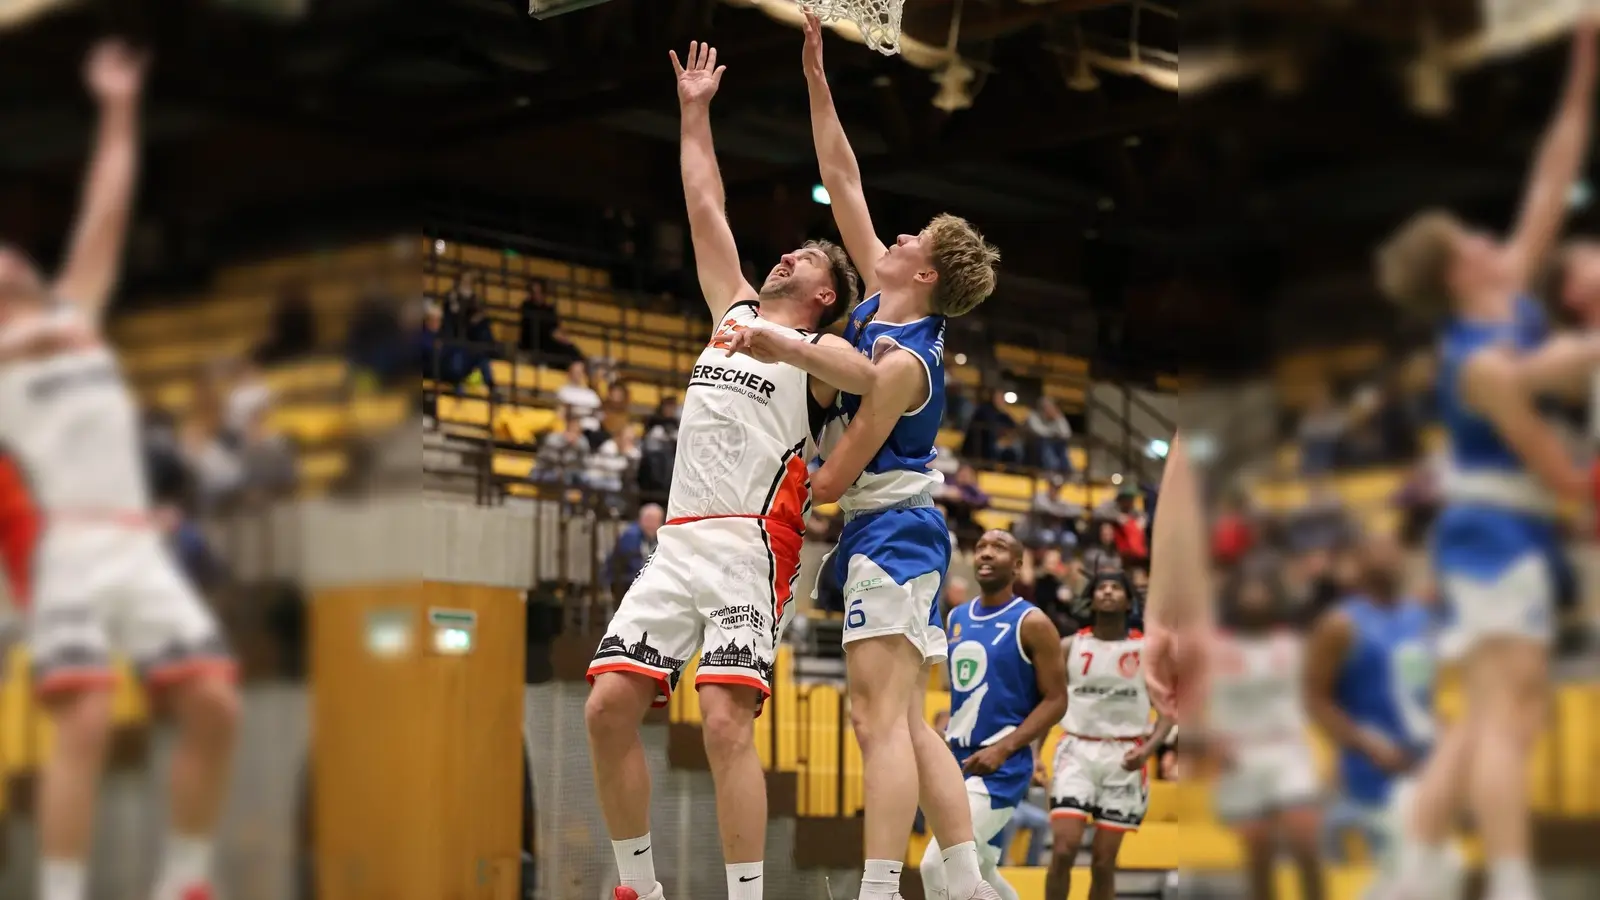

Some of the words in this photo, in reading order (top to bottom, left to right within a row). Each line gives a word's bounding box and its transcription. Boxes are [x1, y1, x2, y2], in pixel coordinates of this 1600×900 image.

[692, 365, 776, 399] ERSCHER
[716, 384, 747, 395] WOHNBAU
[747, 391, 769, 407] GMBH
[709, 603, 750, 619] gerhard
[721, 614, 749, 625] mann
[845, 599, 866, 630] 6
[991, 622, 1011, 646] 7
[1080, 651, 1093, 676] 7
